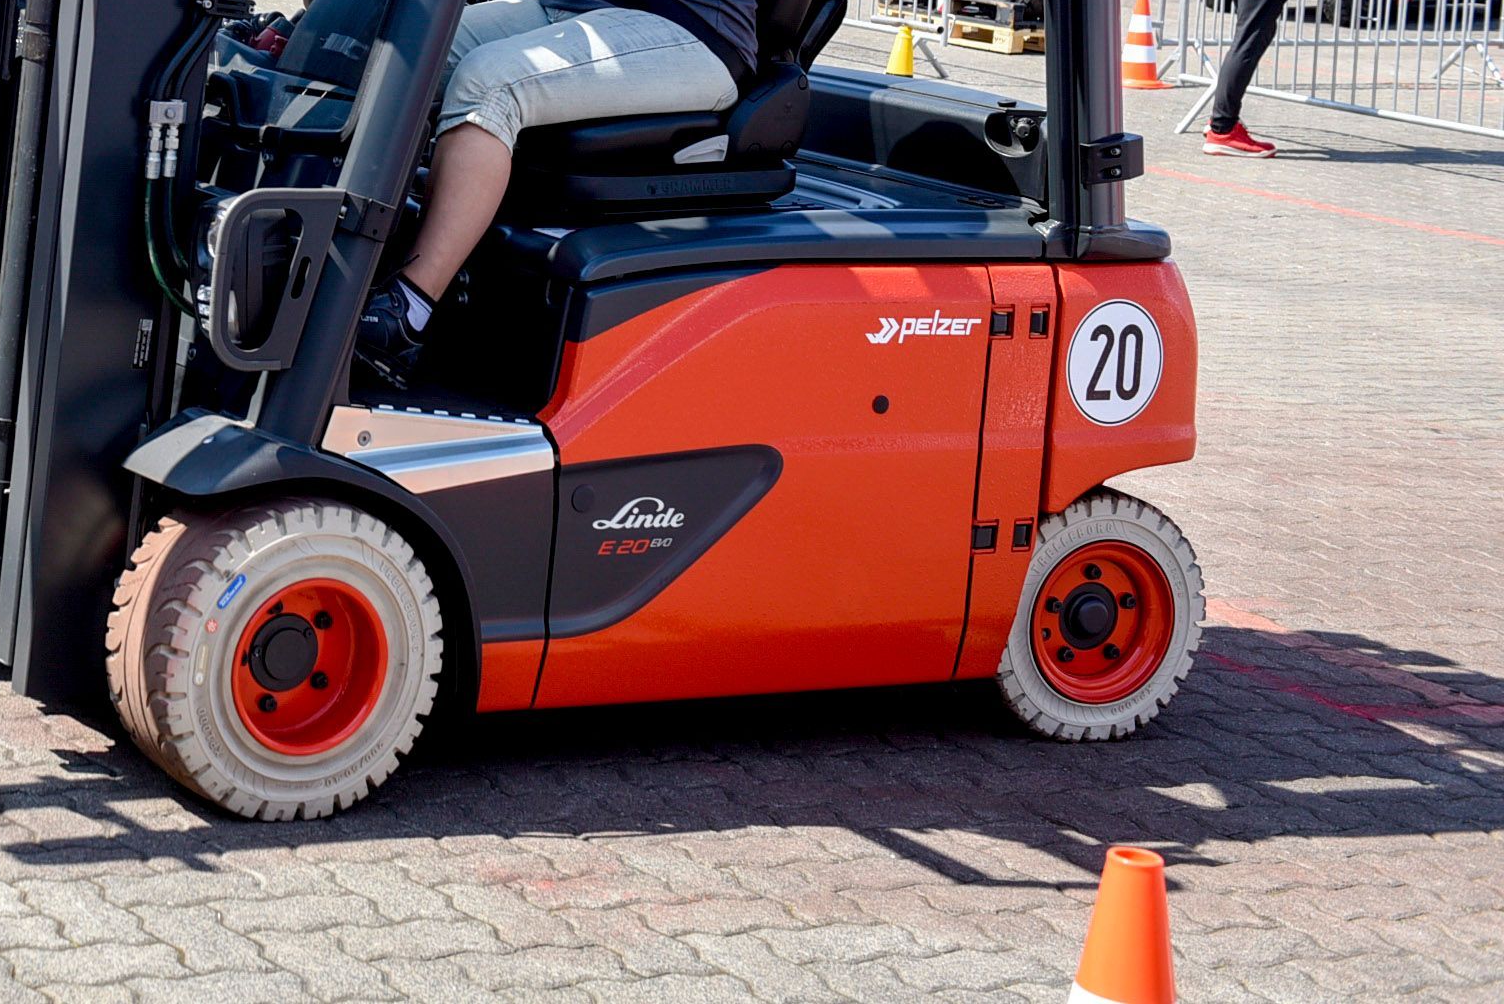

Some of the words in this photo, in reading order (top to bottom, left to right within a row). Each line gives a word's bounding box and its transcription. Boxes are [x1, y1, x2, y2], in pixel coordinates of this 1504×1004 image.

[898, 309, 982, 344] pelzer
[1086, 323, 1144, 401] 20
[592, 496, 685, 530] Linde
